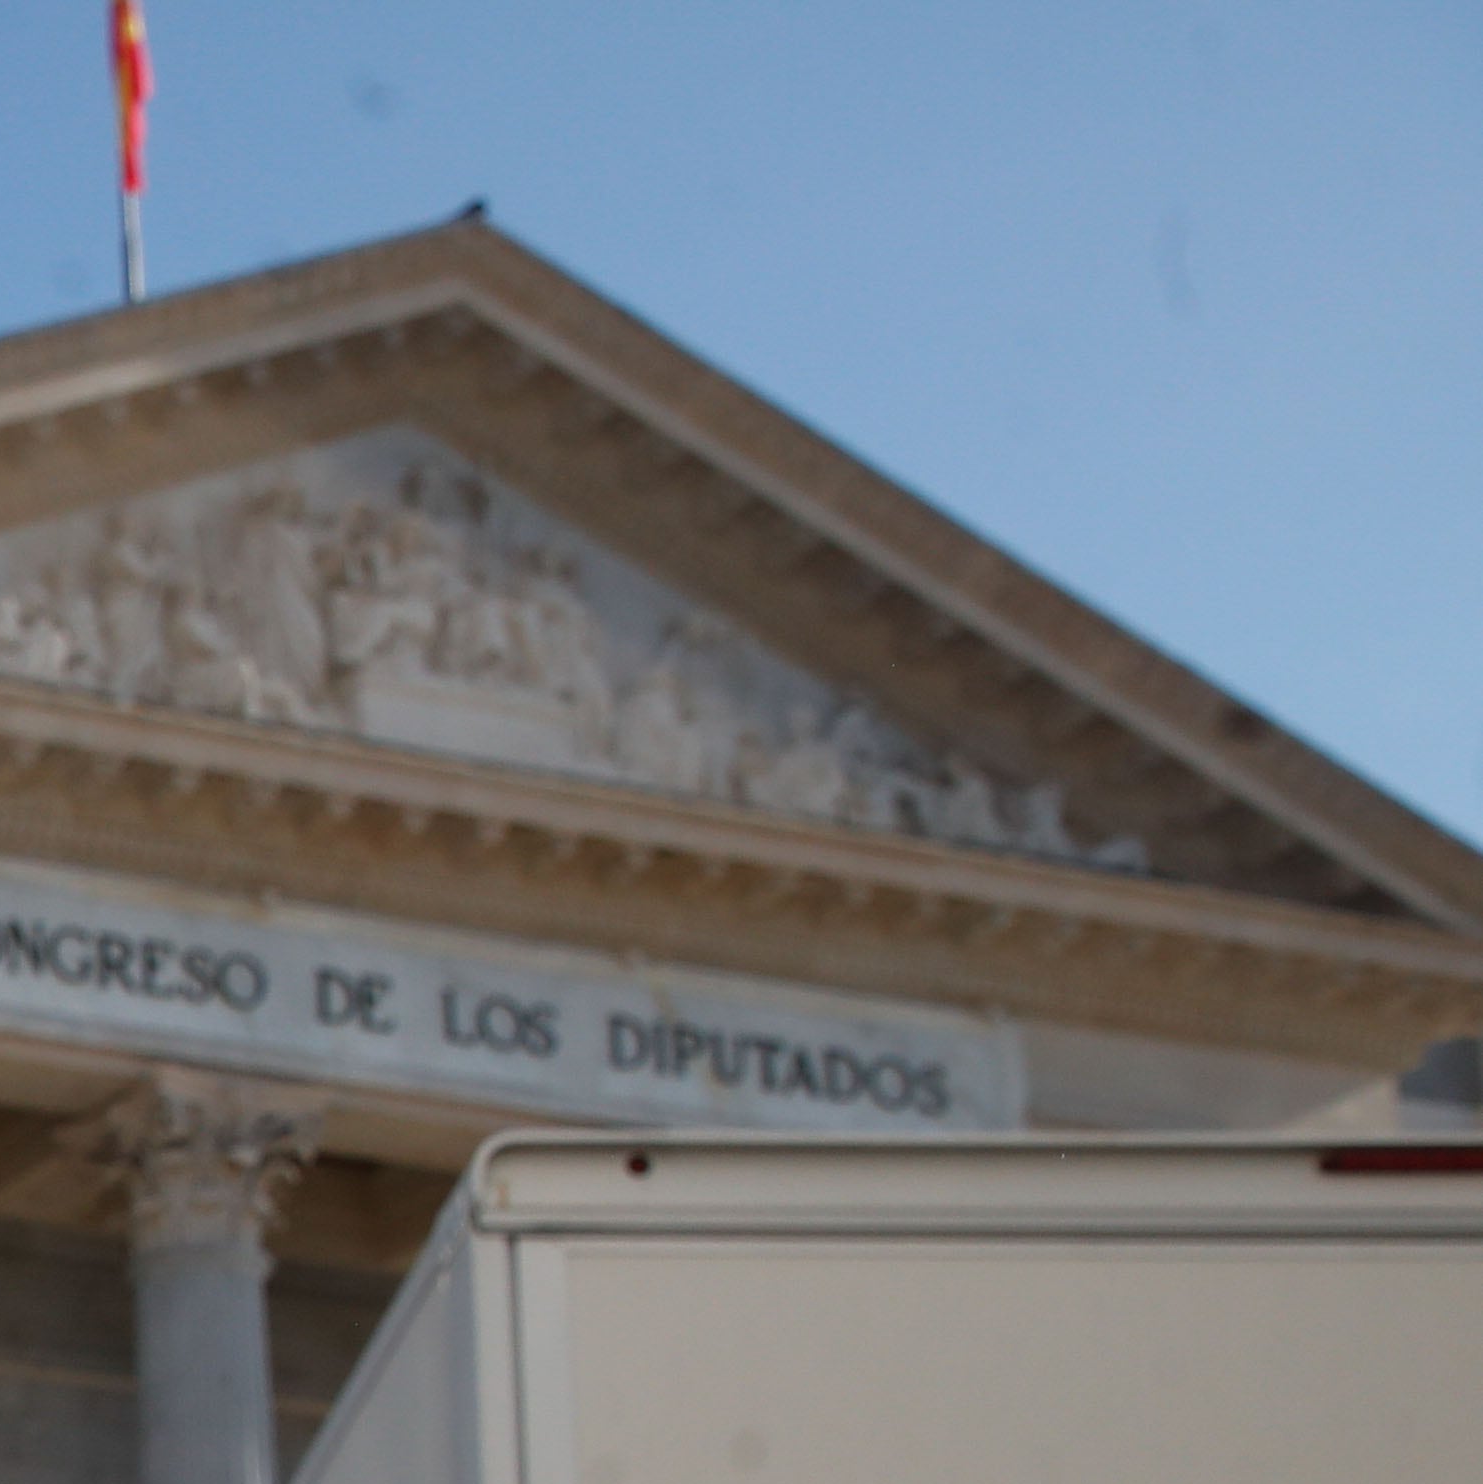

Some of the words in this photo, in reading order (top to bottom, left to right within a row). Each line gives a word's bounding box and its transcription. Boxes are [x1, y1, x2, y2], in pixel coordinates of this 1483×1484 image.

[314, 964, 395, 1036] DE
[439, 984, 560, 1058] LOS
[605, 1011, 950, 1119] DIPUTADOS
